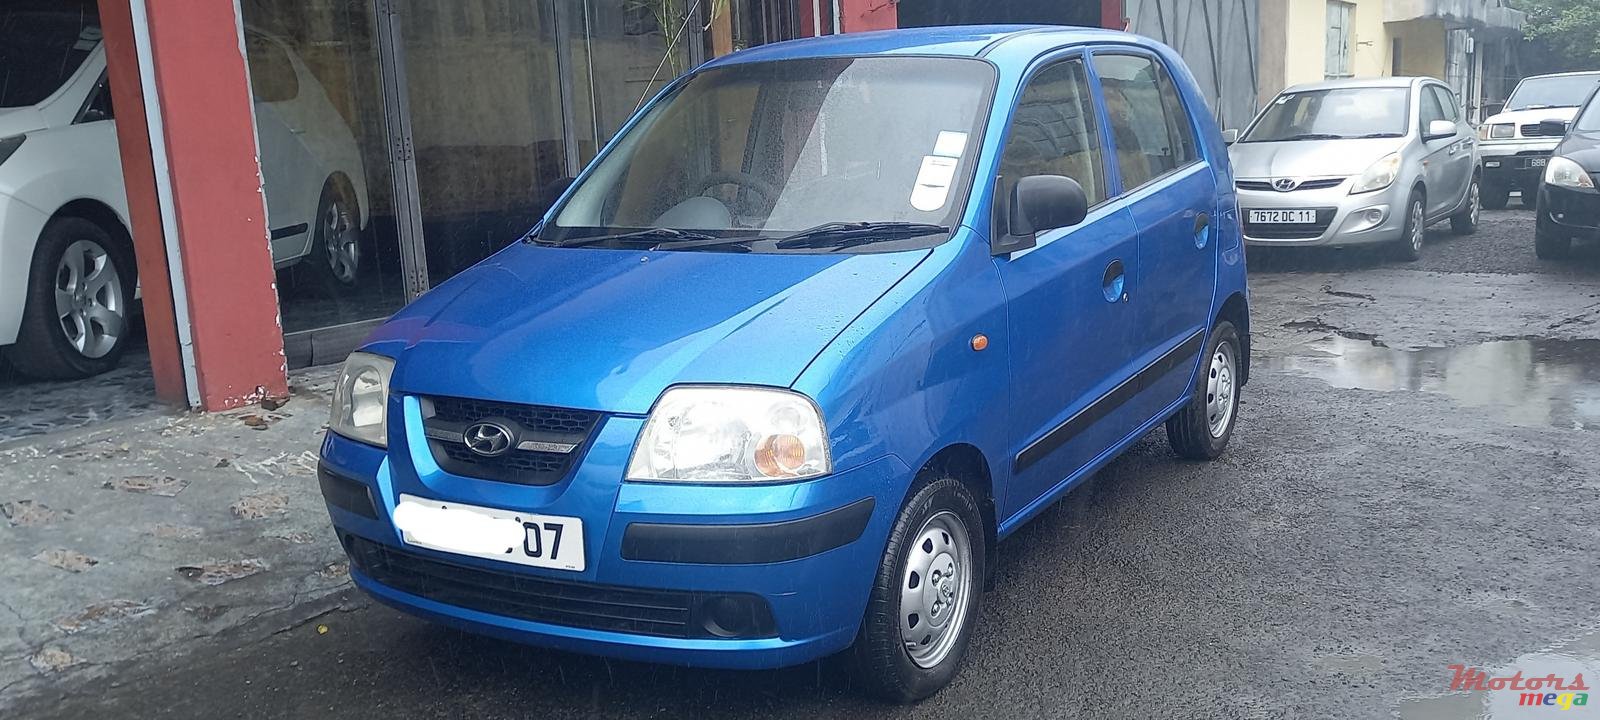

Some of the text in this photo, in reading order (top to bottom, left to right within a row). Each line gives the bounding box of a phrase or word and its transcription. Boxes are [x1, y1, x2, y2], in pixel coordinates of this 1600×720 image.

[1254, 210, 1311, 222] 7672 DC 11
[522, 521, 564, 560] 07
